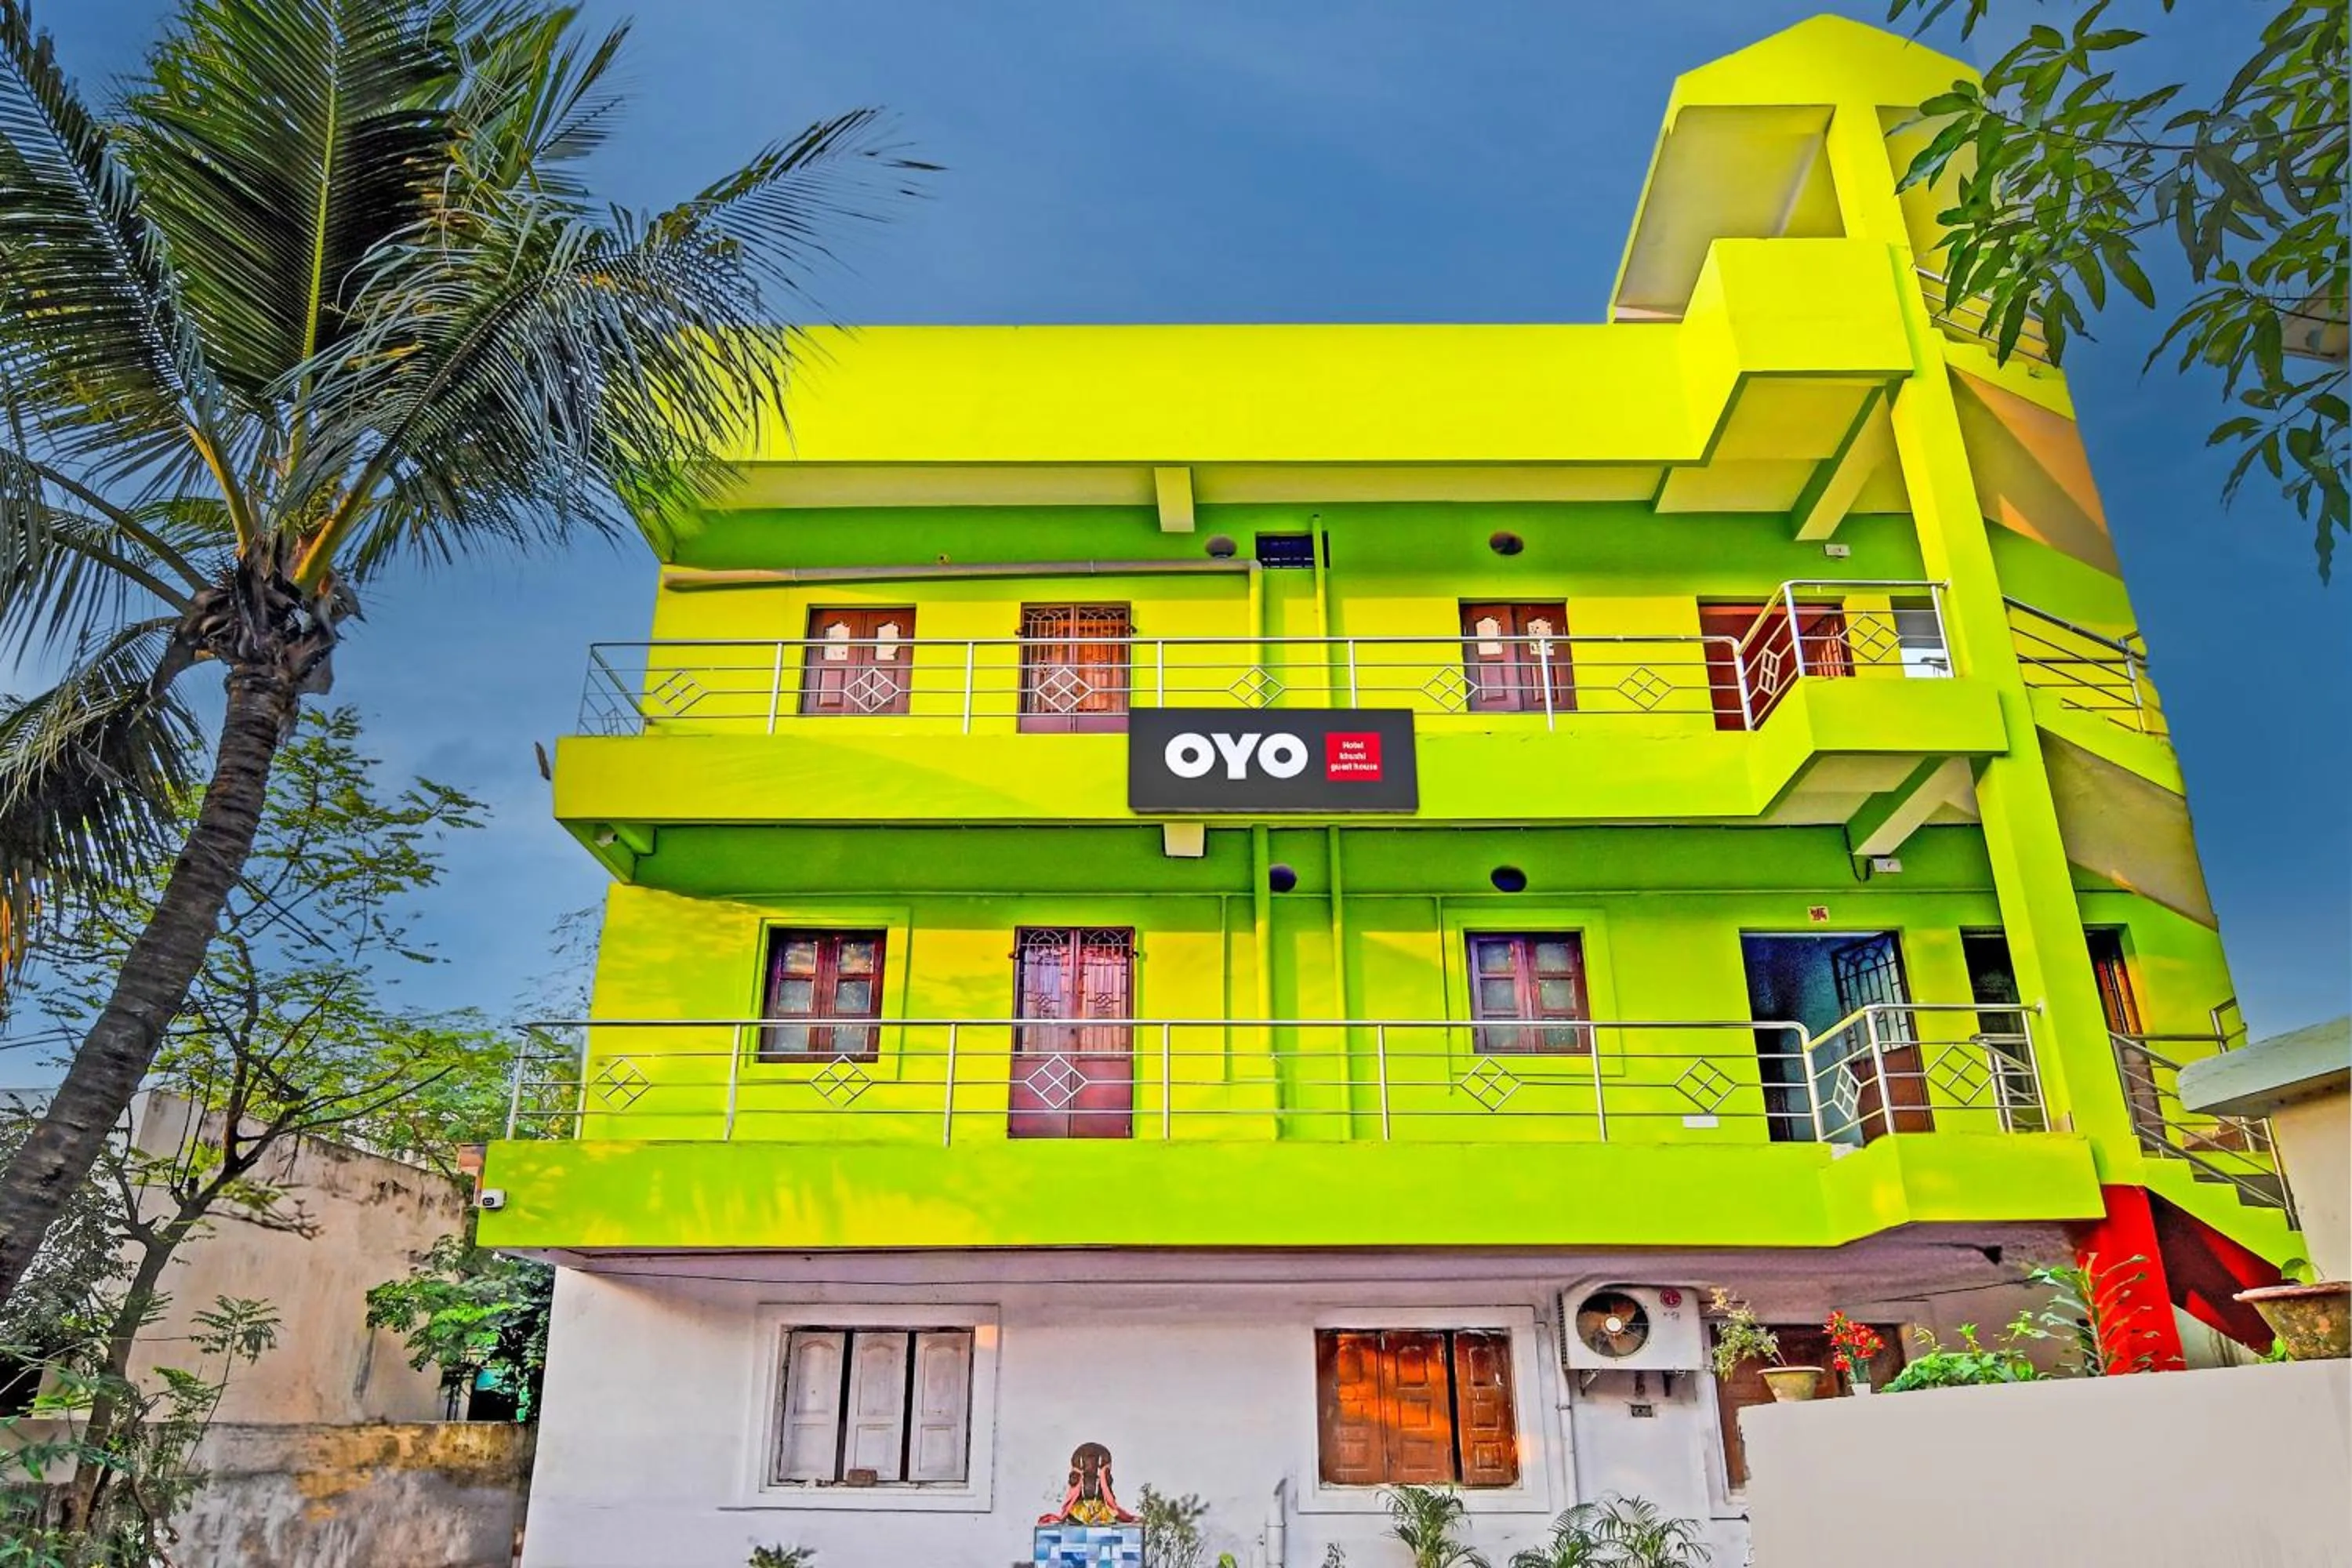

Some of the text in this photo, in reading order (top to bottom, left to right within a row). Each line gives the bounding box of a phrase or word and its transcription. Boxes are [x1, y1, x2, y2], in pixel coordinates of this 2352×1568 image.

[1341, 741, 1364, 750] Hotel
[1164, 732, 1308, 780] OYO
[1330, 763, 1352, 772] guest
